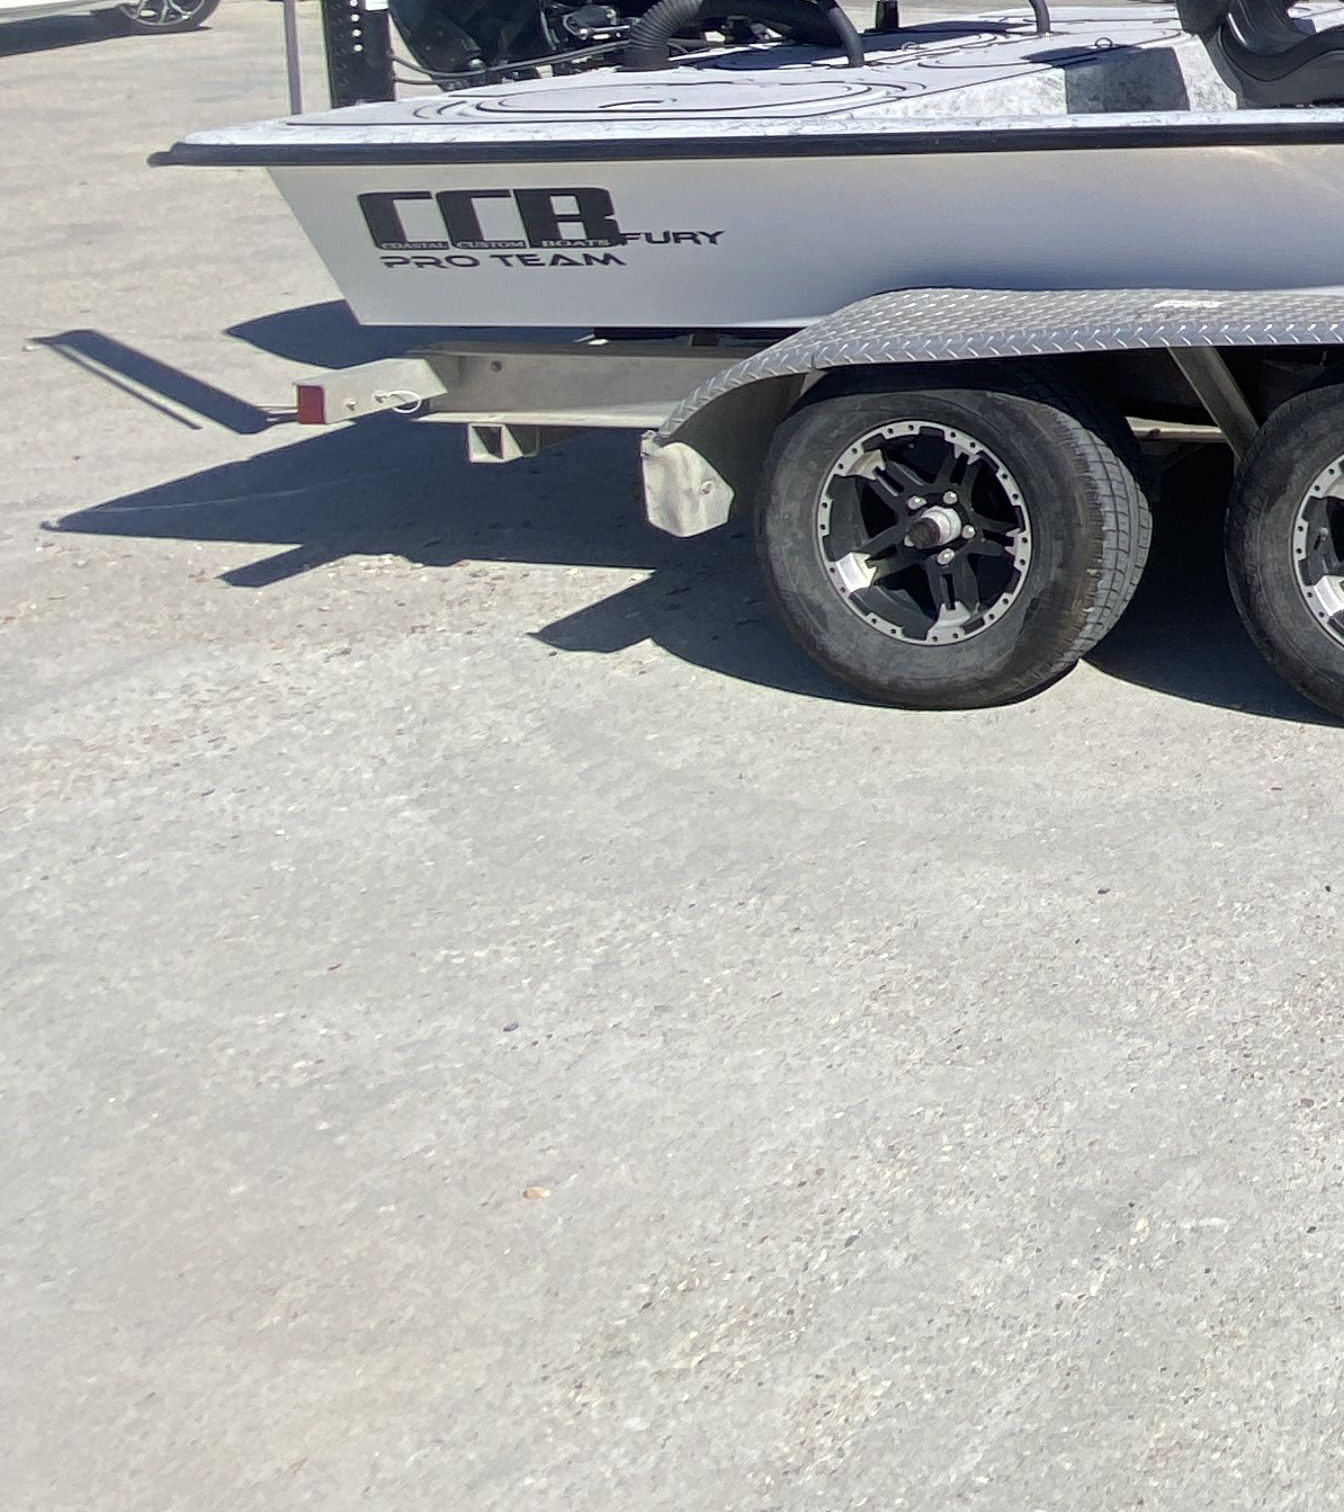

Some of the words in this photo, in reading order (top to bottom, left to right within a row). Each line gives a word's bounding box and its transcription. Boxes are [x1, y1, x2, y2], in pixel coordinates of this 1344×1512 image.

[356, 186, 621, 252] CCB
[620, 229, 726, 247] FURY
[381, 240, 450, 250] COASTAL
[456, 239, 526, 250] CUSTOM
[540, 238, 612, 249] BOATS
[380, 255, 480, 270] PRO
[489, 252, 628, 268] TEAM
